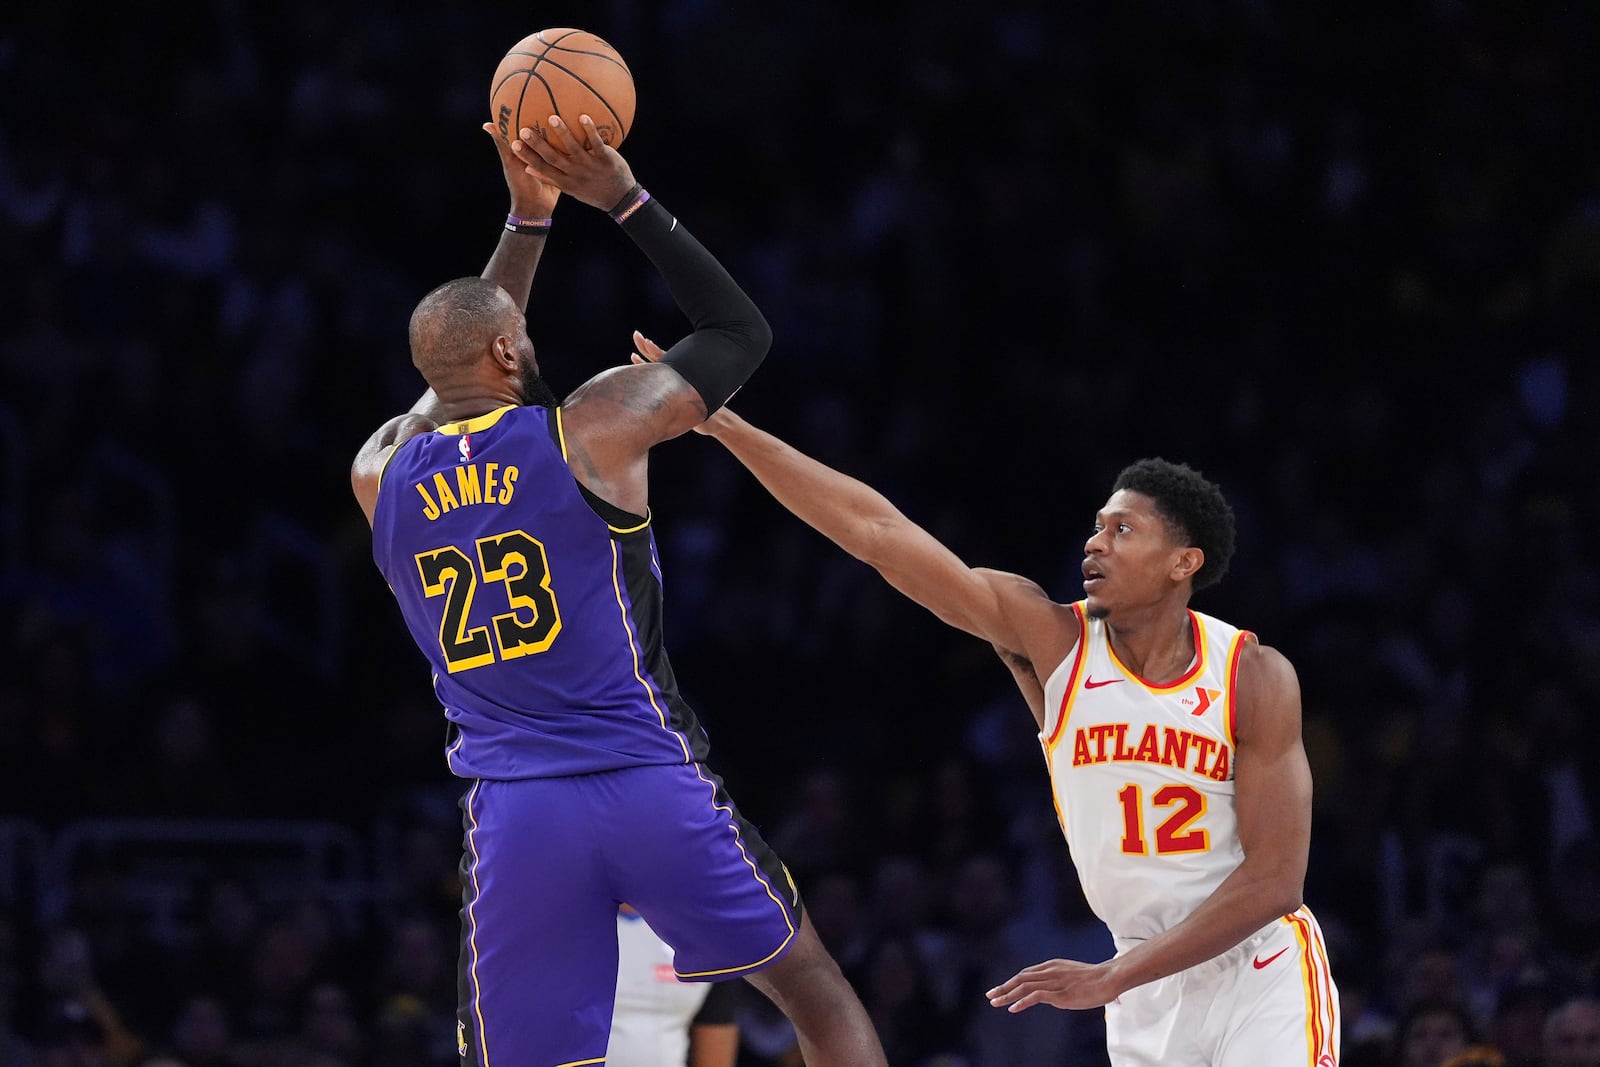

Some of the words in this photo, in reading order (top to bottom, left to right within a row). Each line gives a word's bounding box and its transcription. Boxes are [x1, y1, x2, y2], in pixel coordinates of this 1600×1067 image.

[416, 463, 519, 521] JAMES
[414, 530, 562, 674] 23
[1181, 698, 1194, 707] the
[1072, 723, 1230, 782] ATLANTA
[1118, 783, 1211, 856] 12
